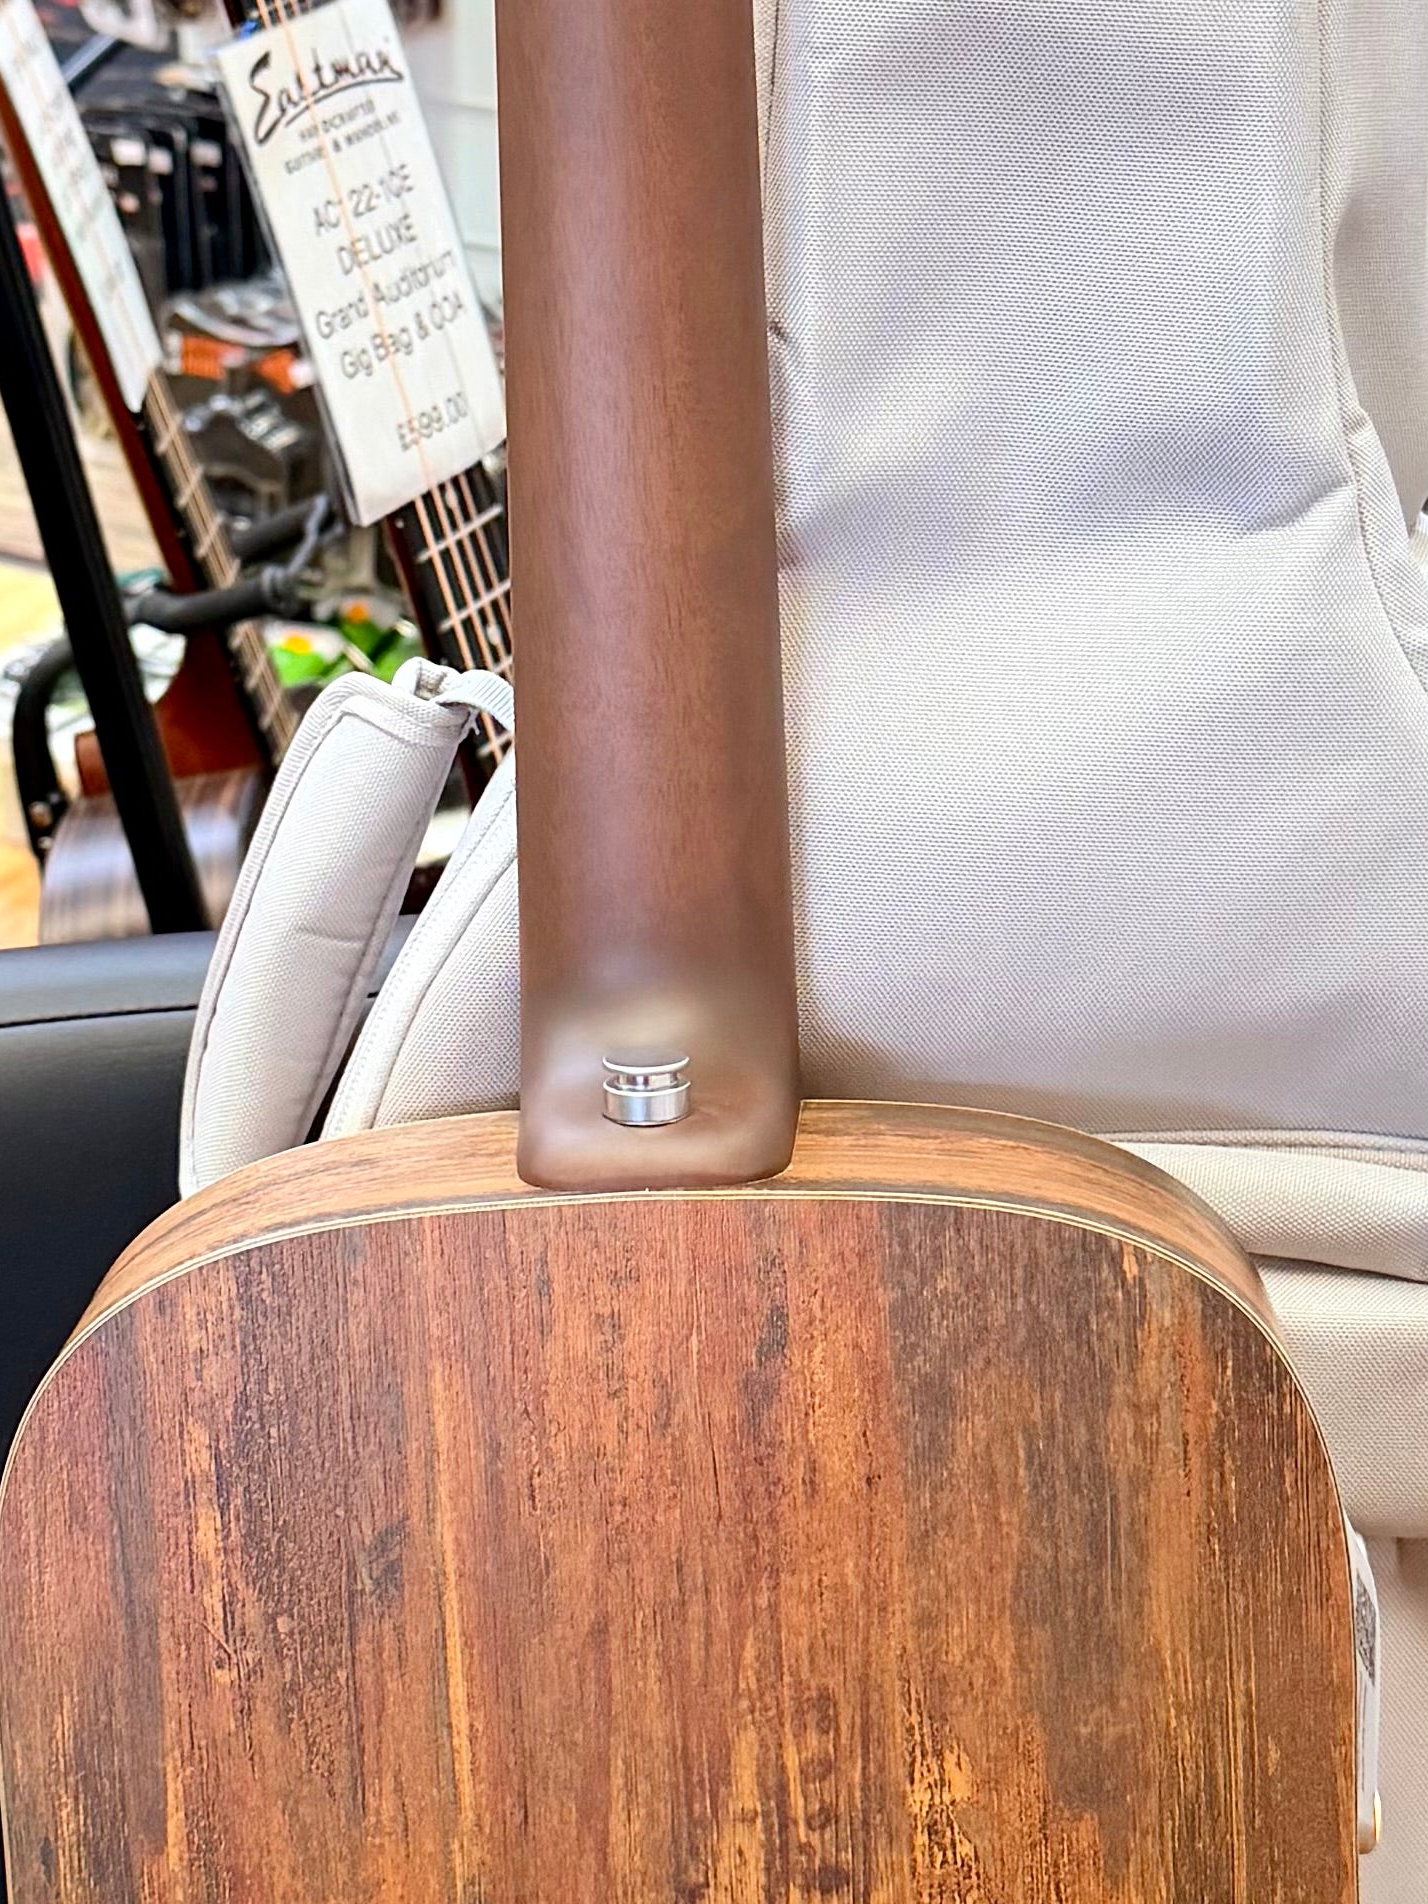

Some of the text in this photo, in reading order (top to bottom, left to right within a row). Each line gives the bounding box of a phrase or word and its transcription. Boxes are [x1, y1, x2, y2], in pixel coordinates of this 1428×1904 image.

[337, 213, 418, 277] DELUXE
[315, 295, 369, 340] Grand
[339, 346, 373, 379] Gig
[371, 325, 413, 363] Bag
[414, 310, 429, 341] &
